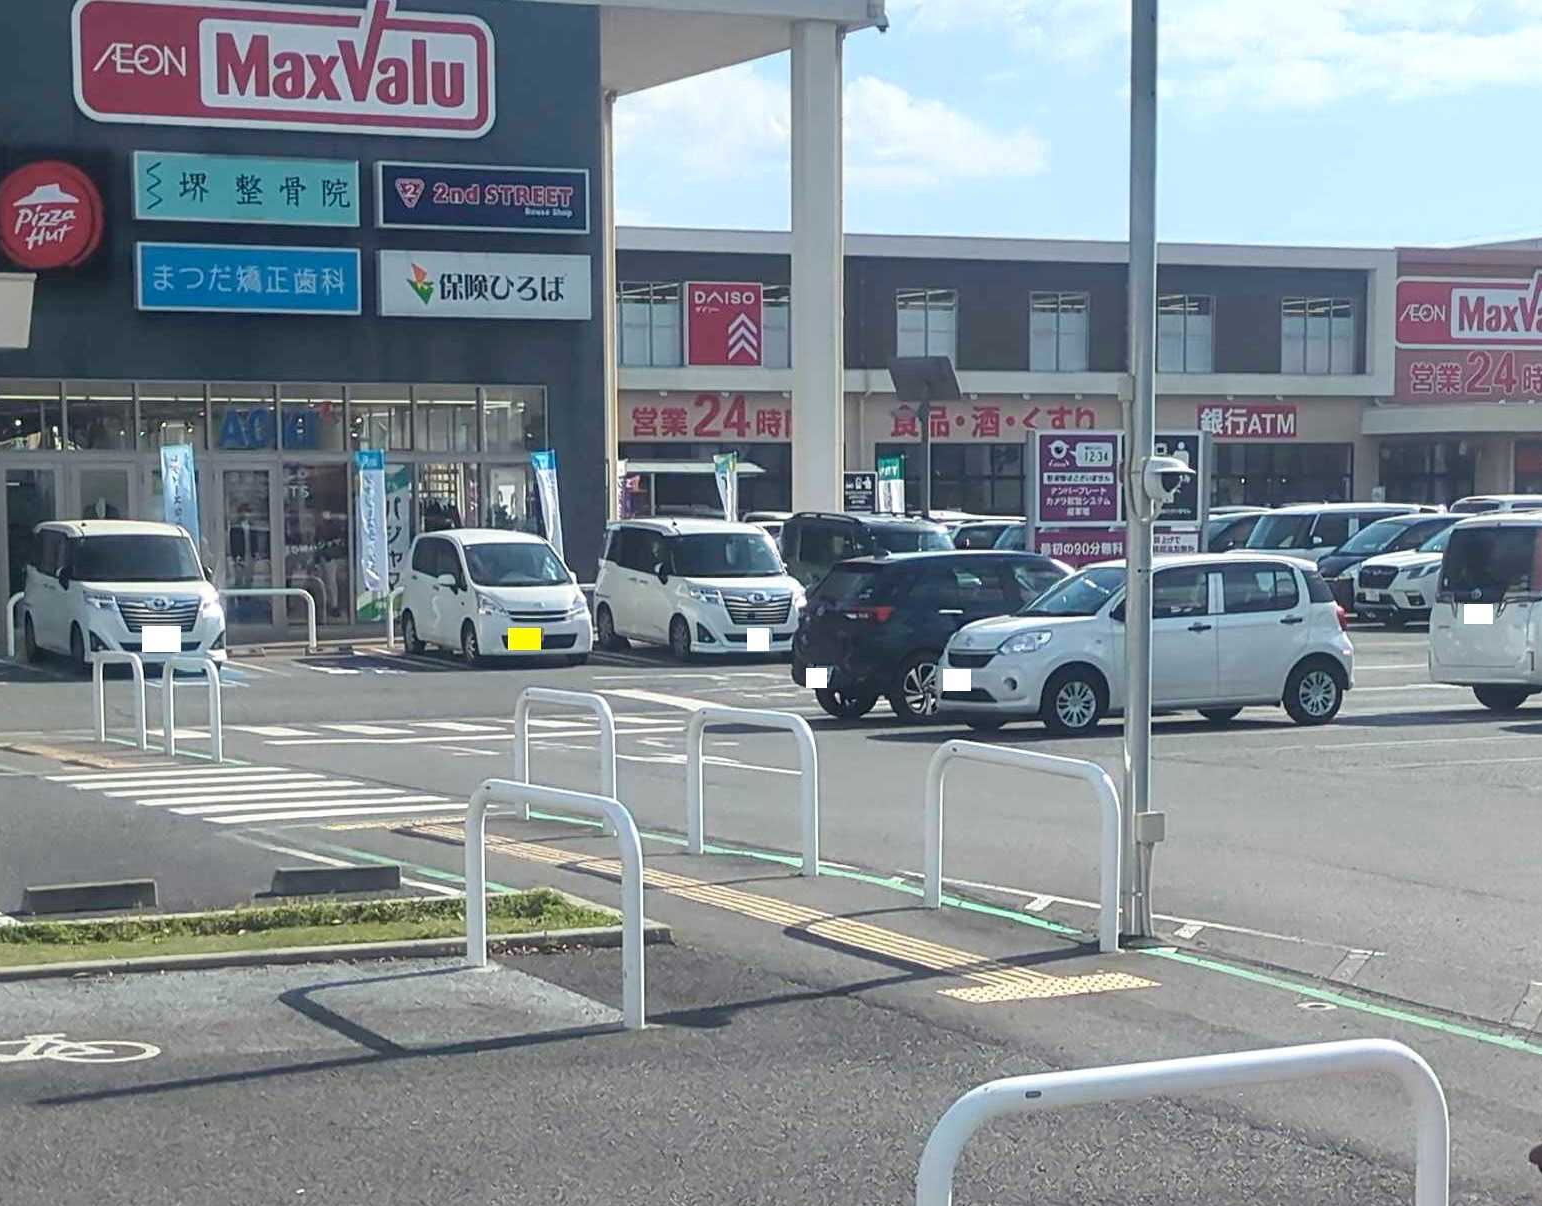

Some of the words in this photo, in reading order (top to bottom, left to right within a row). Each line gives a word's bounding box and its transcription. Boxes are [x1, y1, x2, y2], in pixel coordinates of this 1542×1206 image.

[215, 0, 466, 108] MaxValu
[433, 182, 480, 205] 2nd
[484, 184, 573, 208] STREET
[14, 204, 77, 234] Pizza
[553, 207, 573, 218] Shop
[26, 225, 70, 249] Hut
[153, 264, 345, 296] まつだ矯正歯科
[439, 273, 565, 303] 保険ひろば
[694, 291, 756, 305] DAISO
[632, 392, 792, 438] 営業24時
[1201, 408, 1295, 435] 銀行ATM
